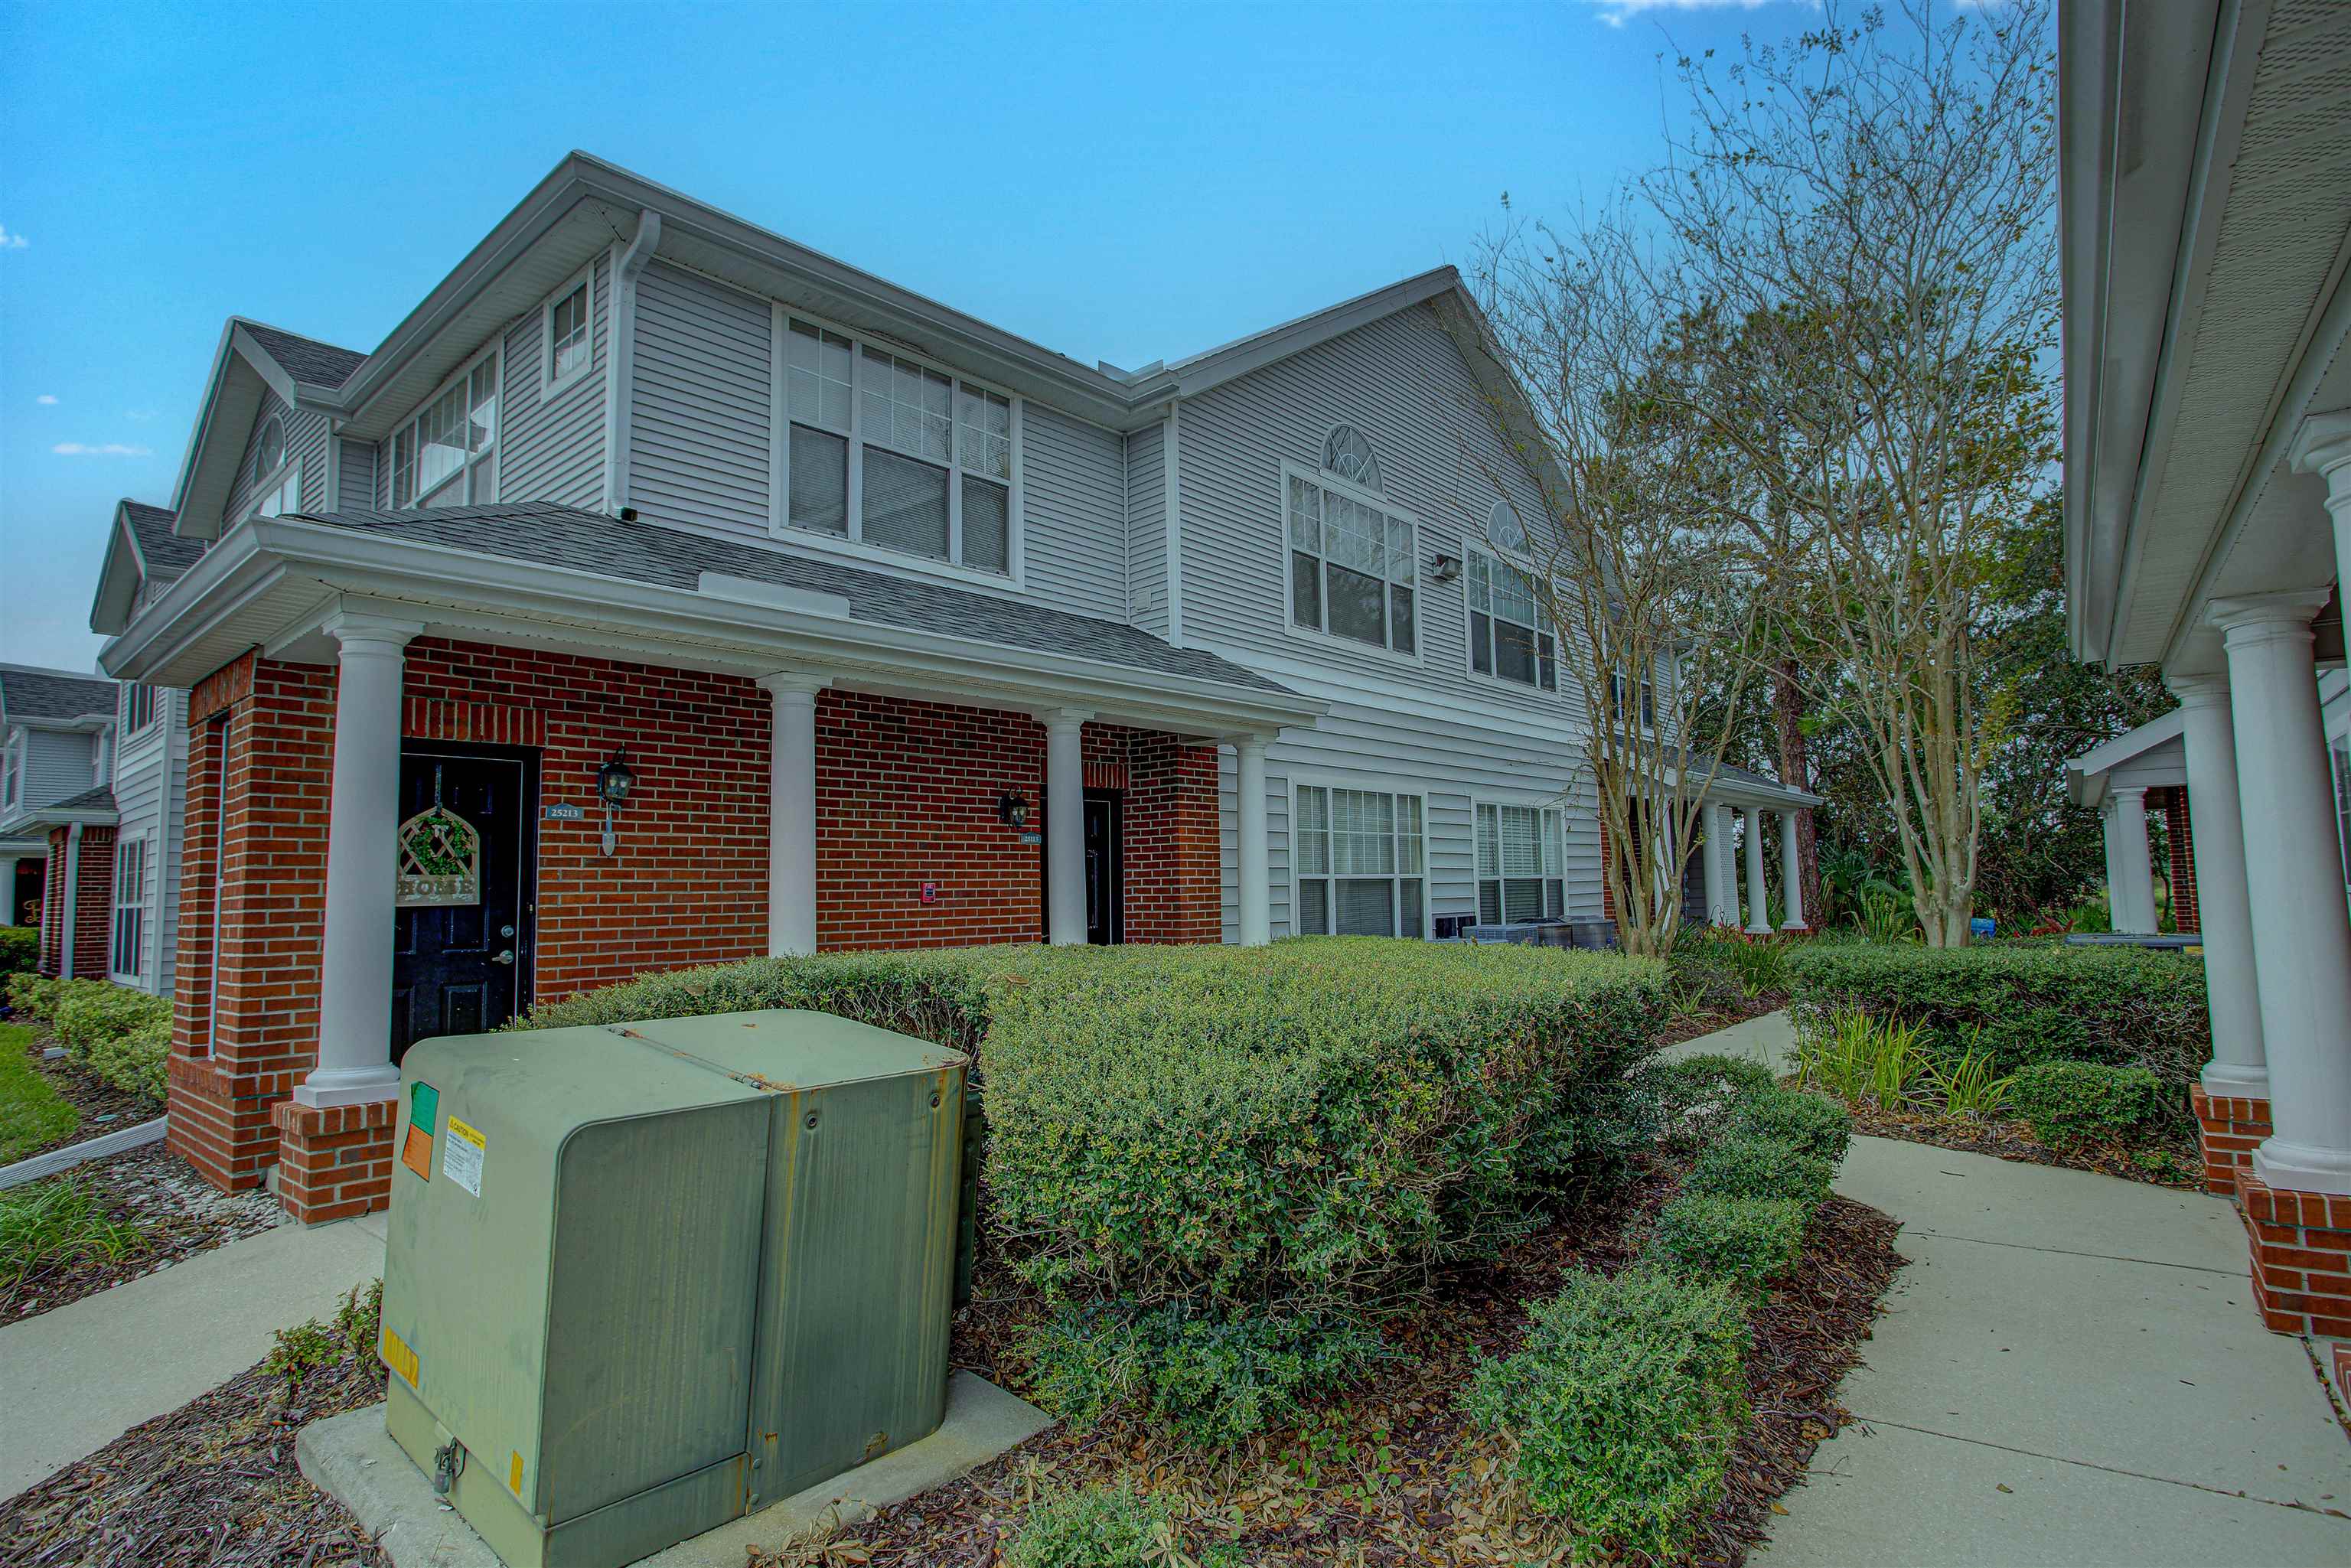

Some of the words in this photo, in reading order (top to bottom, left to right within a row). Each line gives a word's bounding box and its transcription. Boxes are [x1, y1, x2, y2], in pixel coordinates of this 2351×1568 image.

[551, 809, 578, 817] 25213
[397, 880, 475, 895] HOME
[453, 1122, 469, 1138] CAUTION
